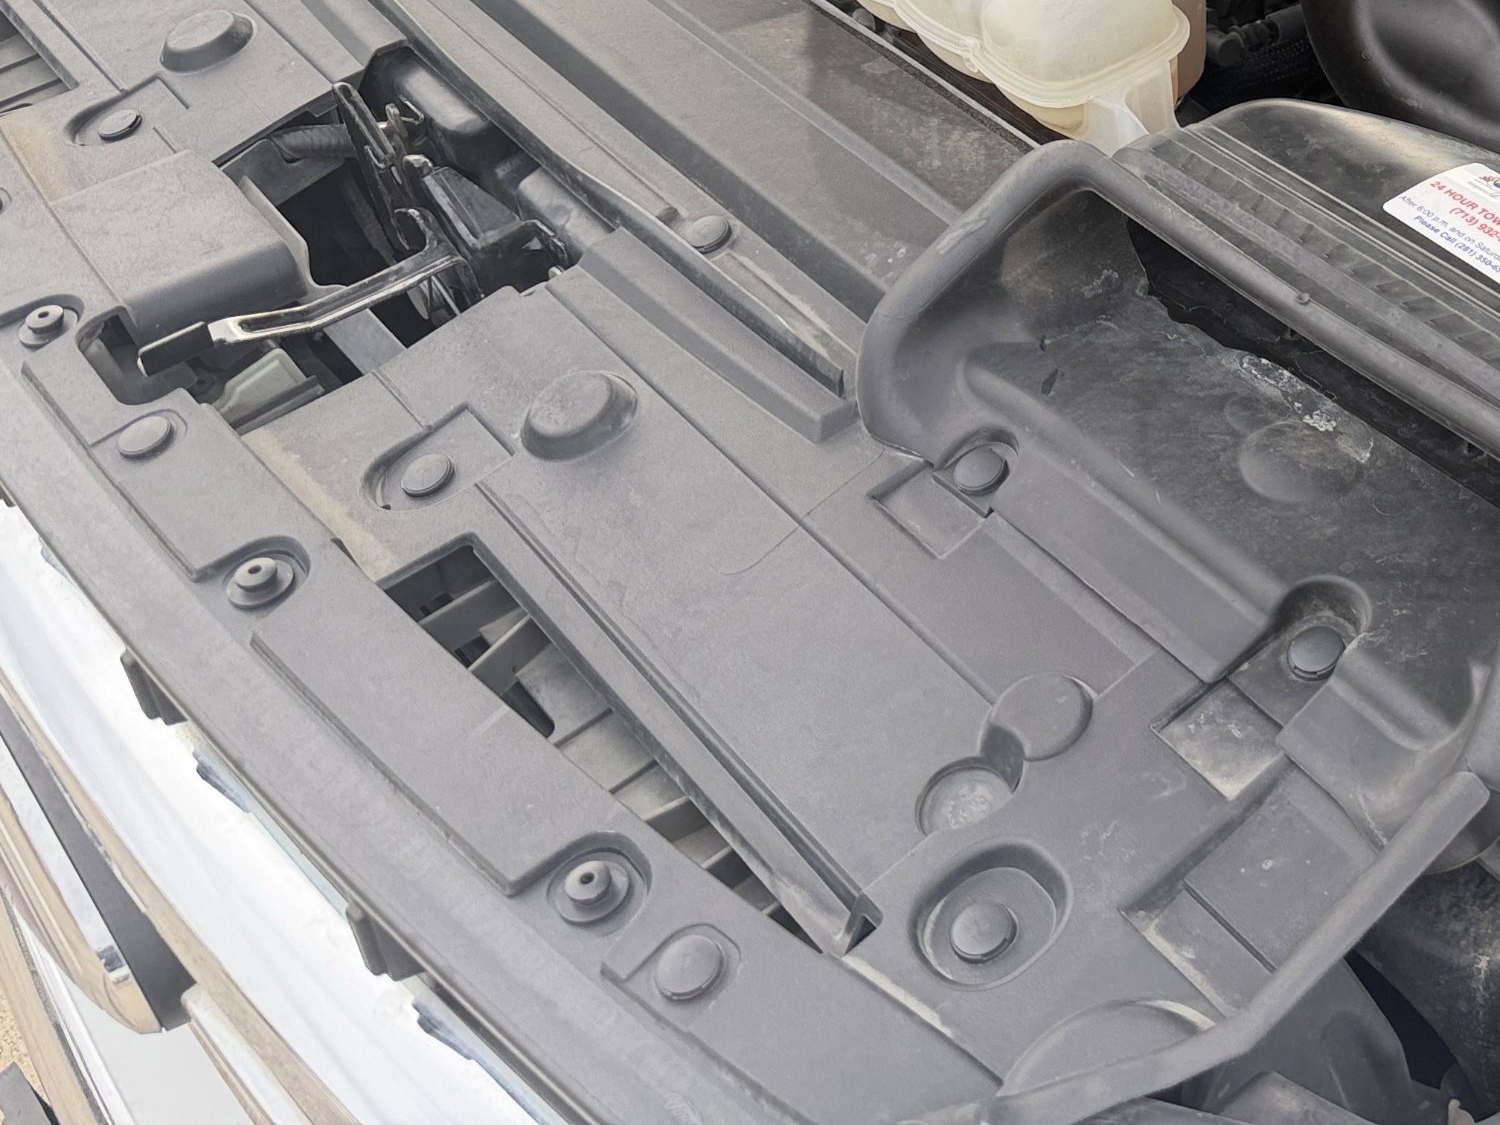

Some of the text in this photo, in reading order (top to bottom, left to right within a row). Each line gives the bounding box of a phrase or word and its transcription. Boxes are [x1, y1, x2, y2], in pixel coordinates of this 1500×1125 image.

[1430, 181, 1446, 191] 24
[1444, 189, 1479, 210] HOUR
[1400, 196, 1418, 207] After
[1449, 227, 1466, 237] and
[1464, 235, 1476, 244] on
[1449, 207, 1479, 226] (713)
[1414, 215, 1440, 233] Please
[1440, 231, 1458, 244] Call
[1455, 242, 1477, 257] (281)
